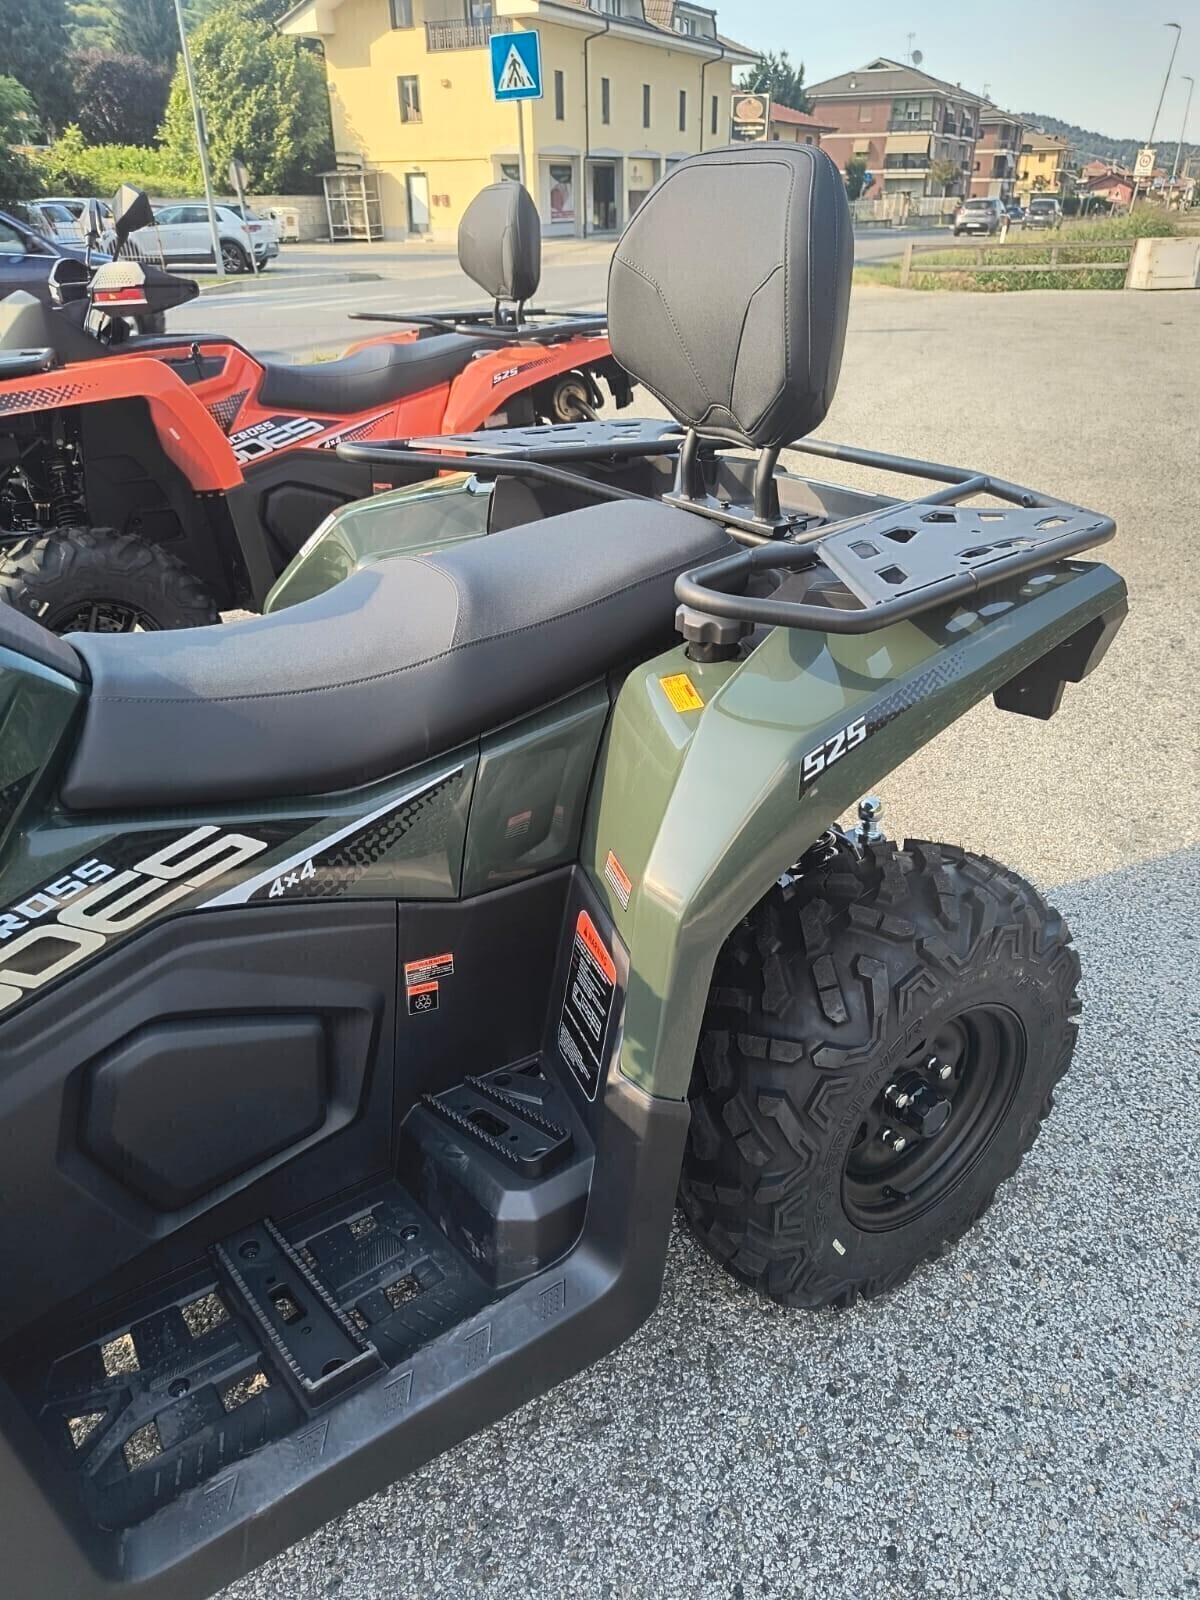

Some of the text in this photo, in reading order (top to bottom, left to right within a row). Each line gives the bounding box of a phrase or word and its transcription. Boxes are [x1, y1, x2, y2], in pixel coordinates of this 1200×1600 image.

[493, 367, 518, 384] 525
[228, 421, 276, 445] CROSS
[803, 715, 867, 782] 525
[269, 859, 316, 899] 4x4
